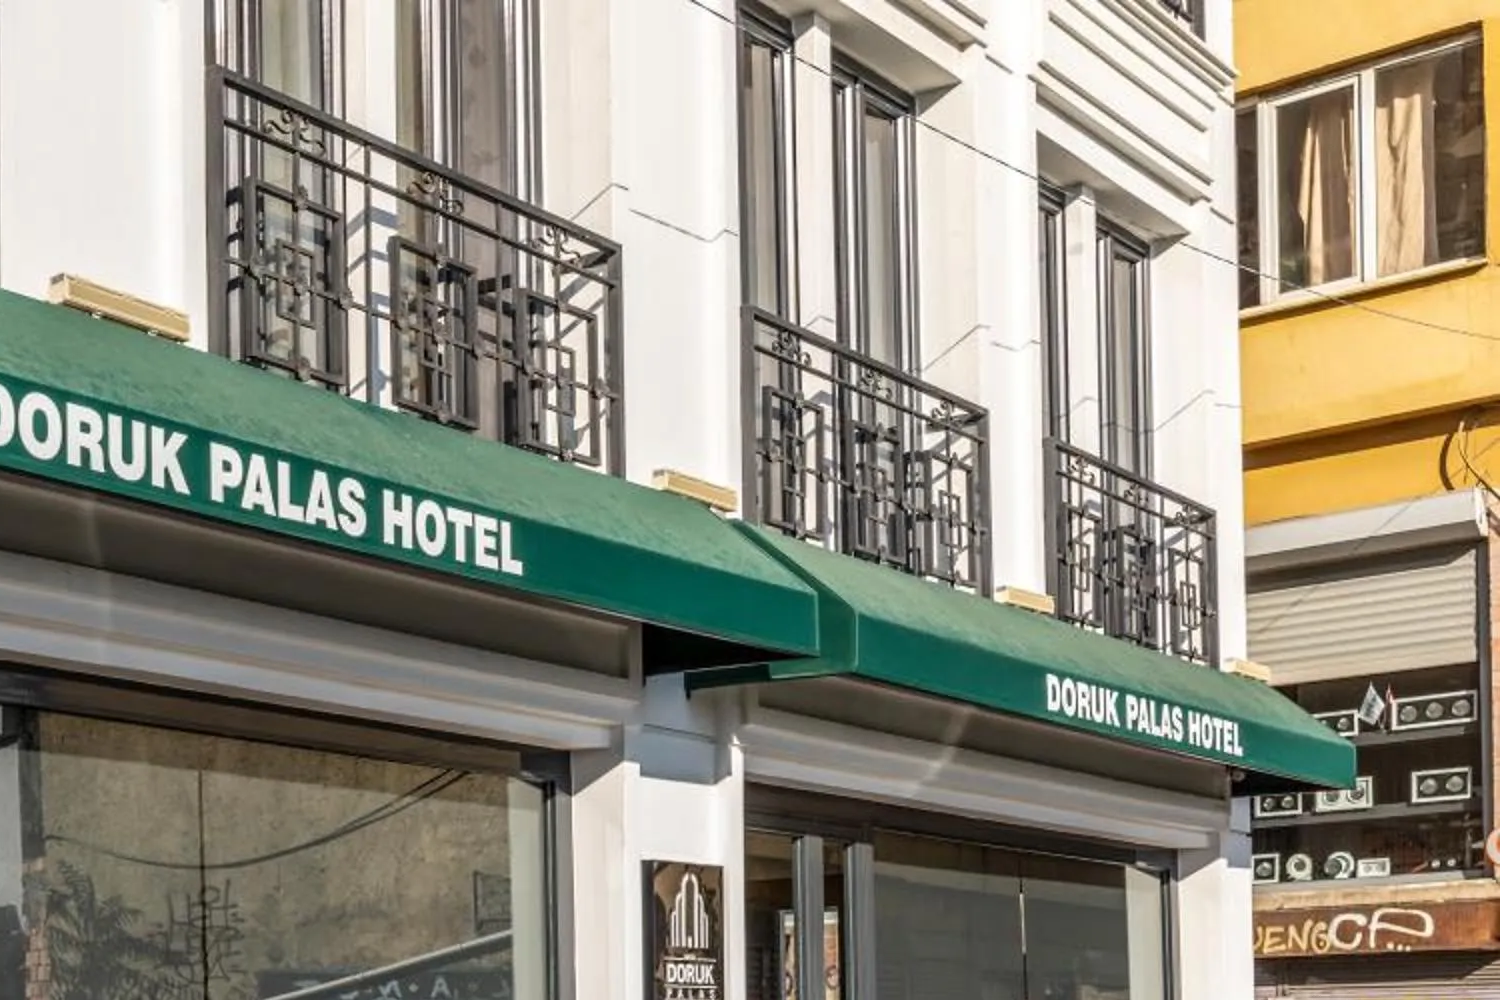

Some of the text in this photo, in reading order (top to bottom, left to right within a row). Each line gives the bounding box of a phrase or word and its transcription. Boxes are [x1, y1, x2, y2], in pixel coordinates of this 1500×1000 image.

[210, 441, 367, 538] PALAS
[383, 488, 524, 576] HOTEL
[1045, 673, 1244, 757] DORUK PALAS HOTEL
[666, 963, 715, 984] DORUK
